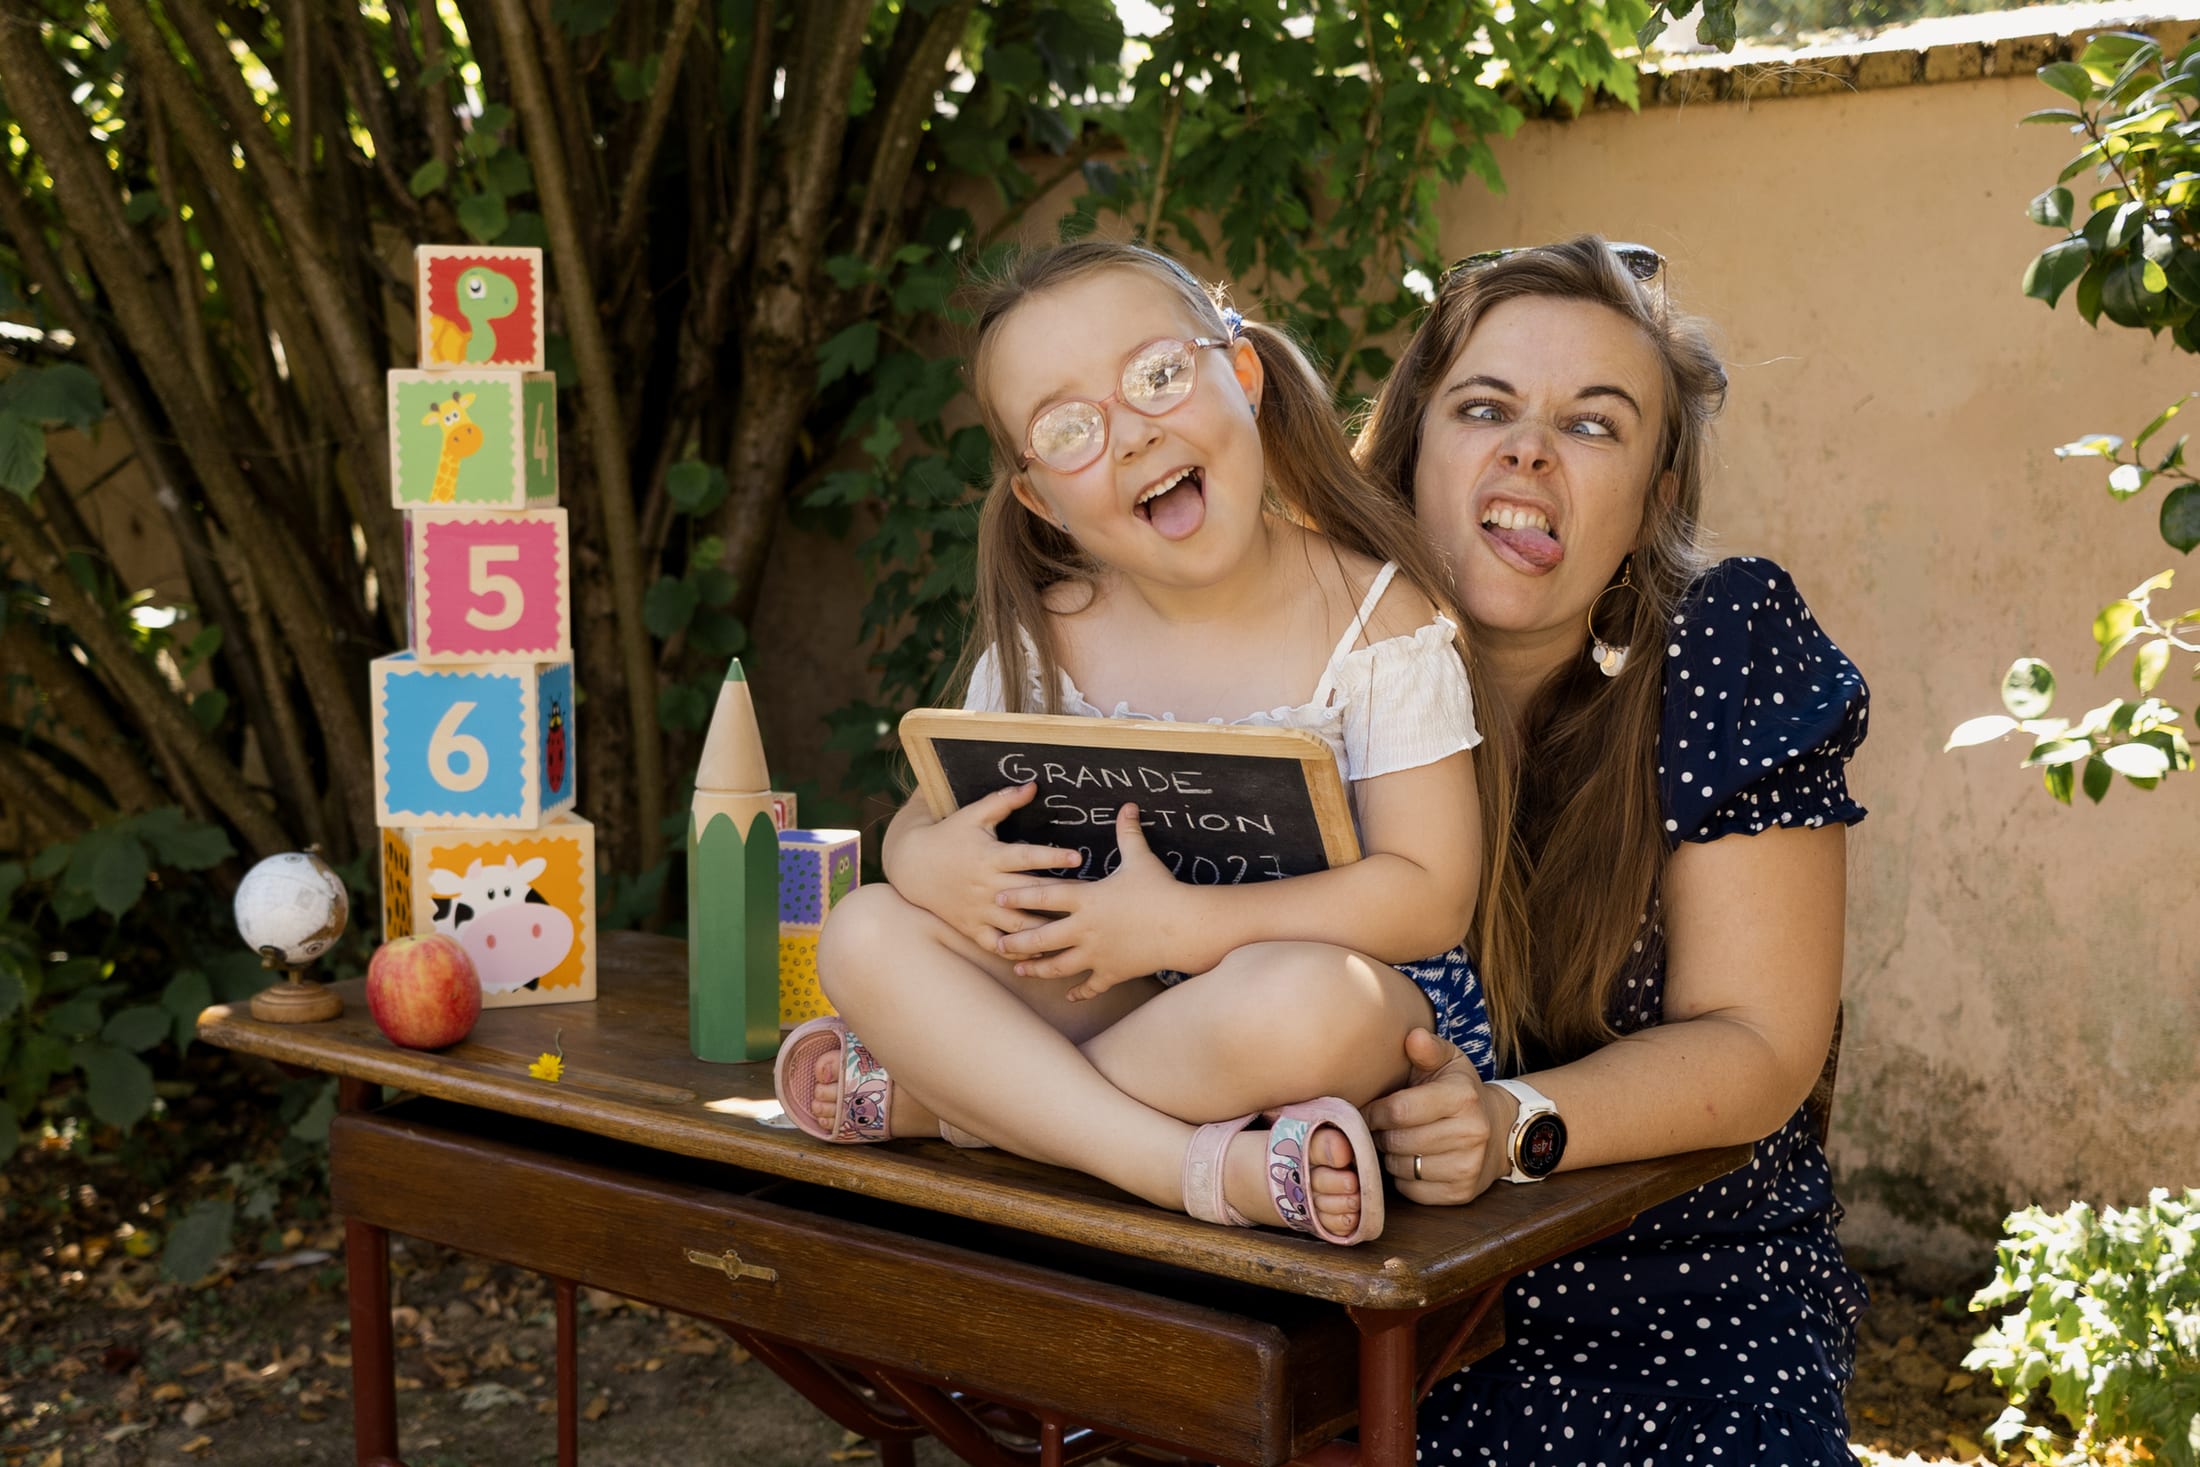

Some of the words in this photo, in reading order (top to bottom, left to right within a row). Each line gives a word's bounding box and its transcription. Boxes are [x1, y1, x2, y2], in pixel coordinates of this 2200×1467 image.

[533, 402, 548, 477] 4
[465, 545, 524, 631] 5
[428, 701, 489, 792] 6
[998, 753, 1213, 794] GRANDE
